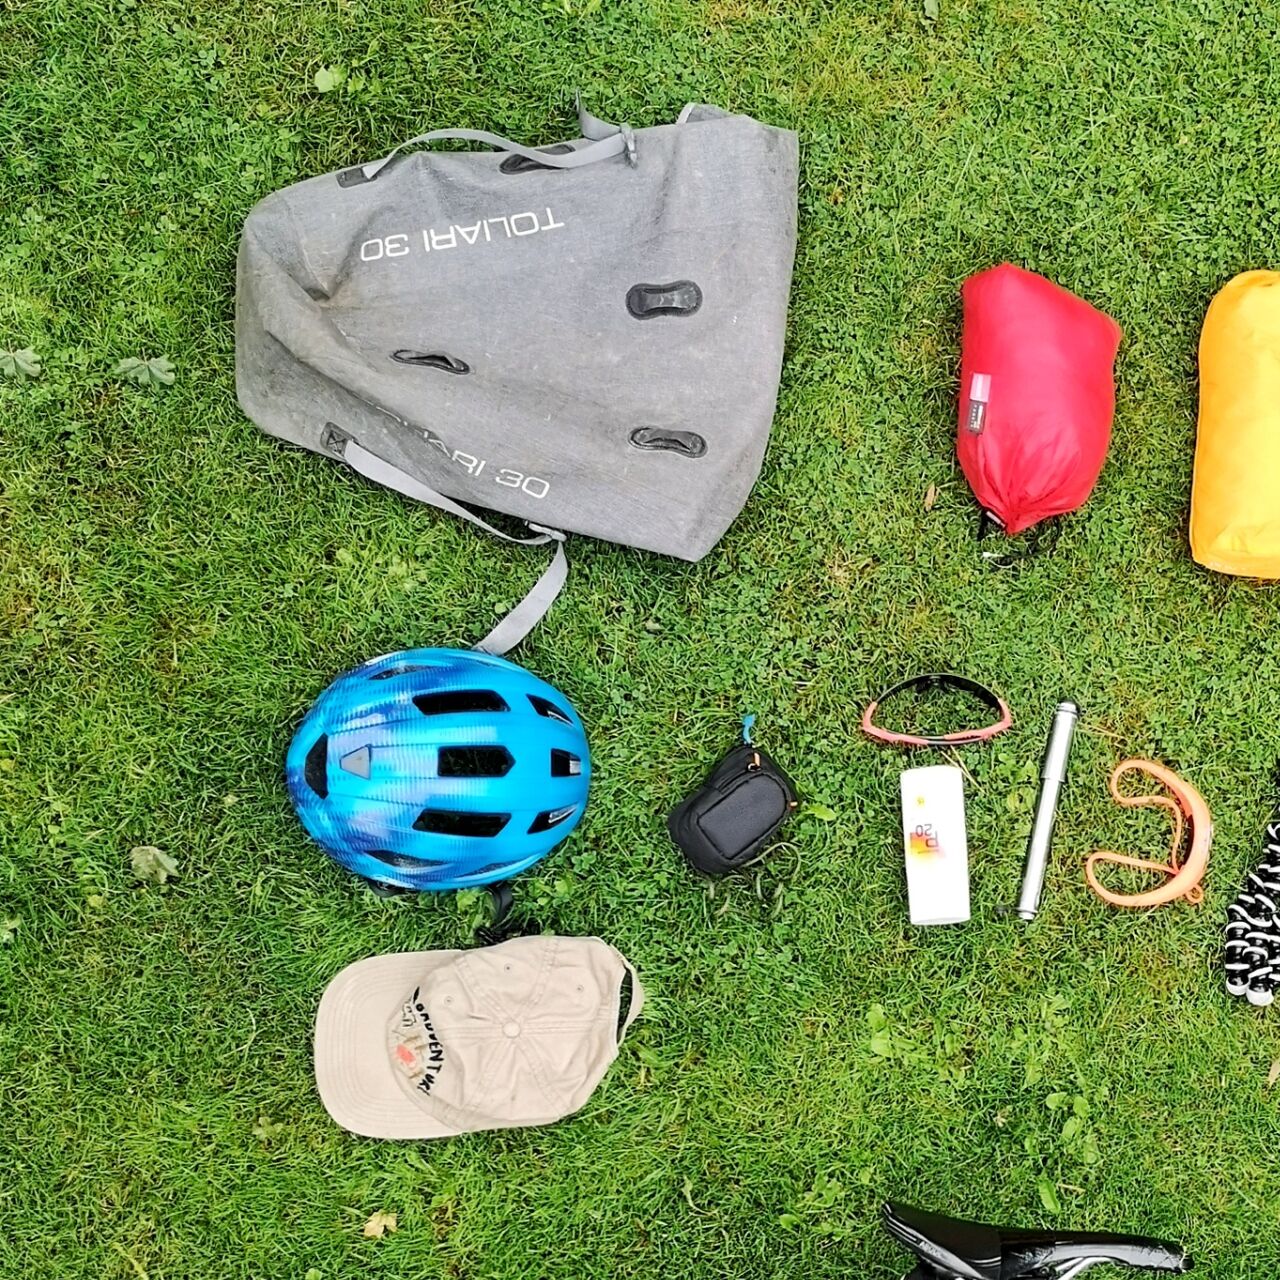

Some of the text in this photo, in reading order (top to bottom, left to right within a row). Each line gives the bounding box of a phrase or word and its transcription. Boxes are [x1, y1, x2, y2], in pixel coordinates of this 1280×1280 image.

[360, 207, 566, 262] TOLIARI 30
[494, 468, 550, 499] 30
